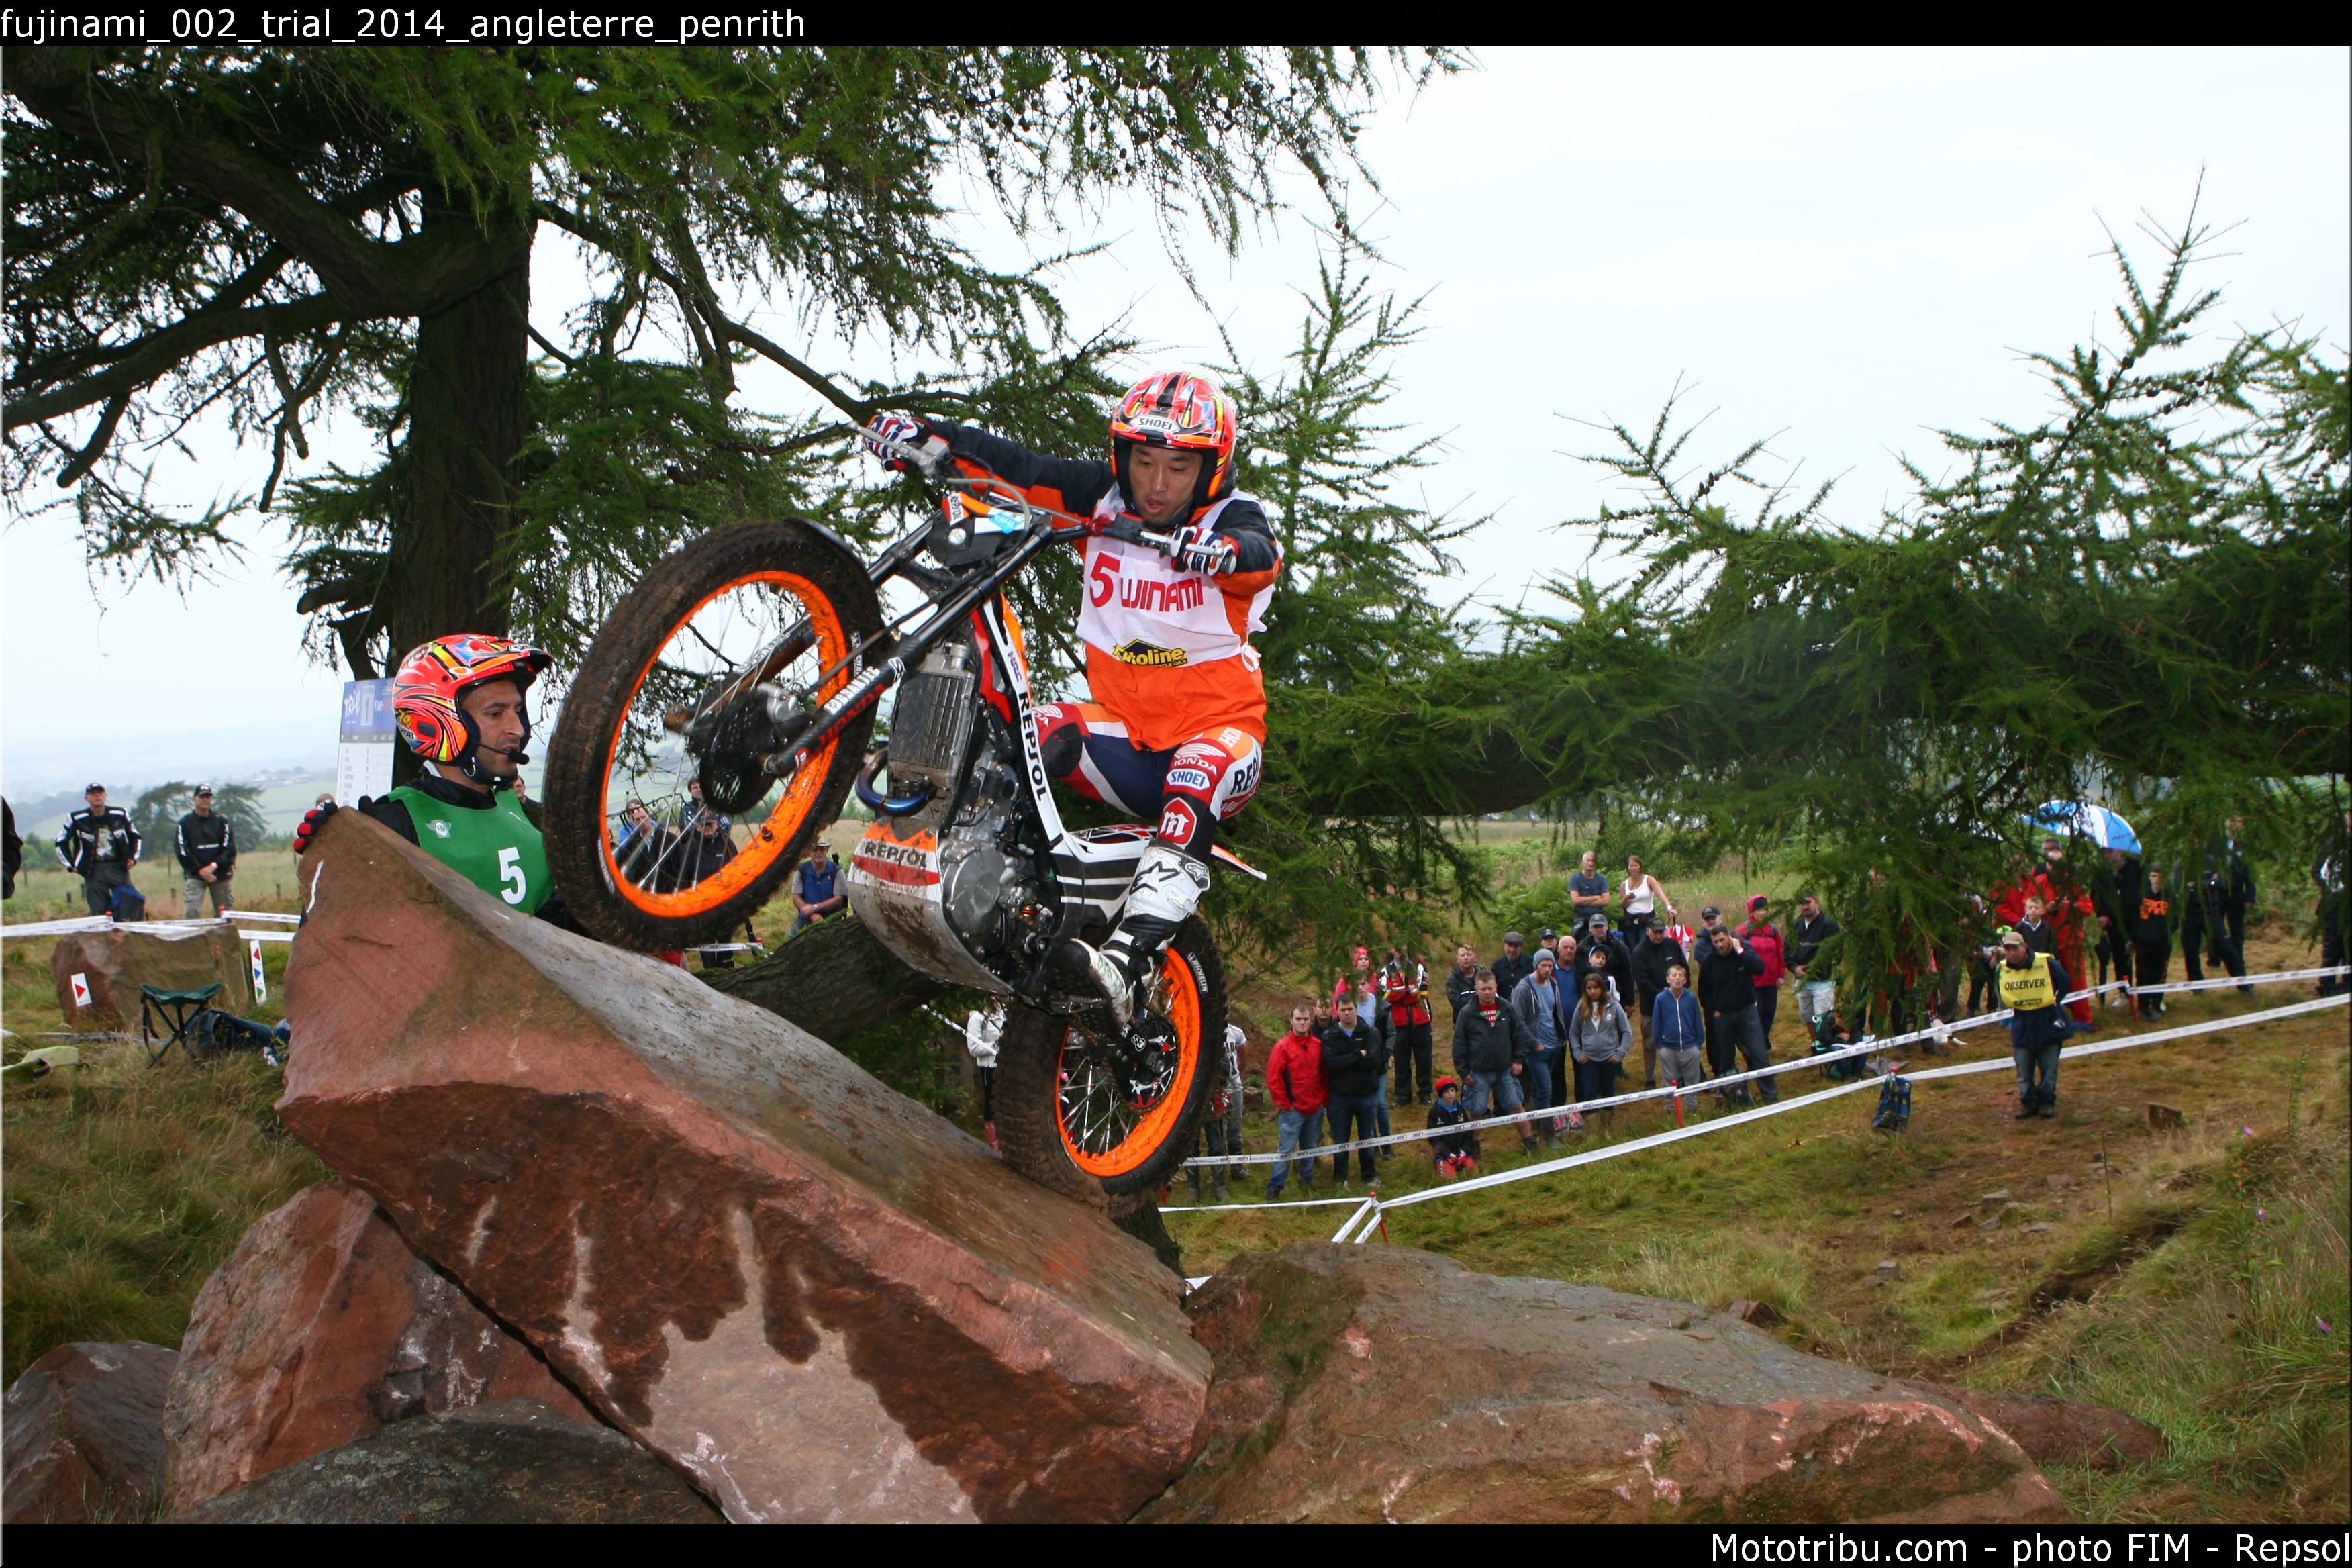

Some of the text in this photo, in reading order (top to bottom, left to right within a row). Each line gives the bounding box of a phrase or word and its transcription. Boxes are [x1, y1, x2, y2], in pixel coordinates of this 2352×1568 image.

[1138, 418, 1173, 430] SHOEI
[1090, 552, 1120, 607] 5
[1019, 691, 1048, 801] REPSOL
[1171, 771, 1206, 787] SHOEI
[865, 842, 926, 867] REPSOL
[498, 846, 526, 905] 5
[1190, 957, 1209, 993] MICHELIN
[2004, 979, 2045, 991] OBSERVER
